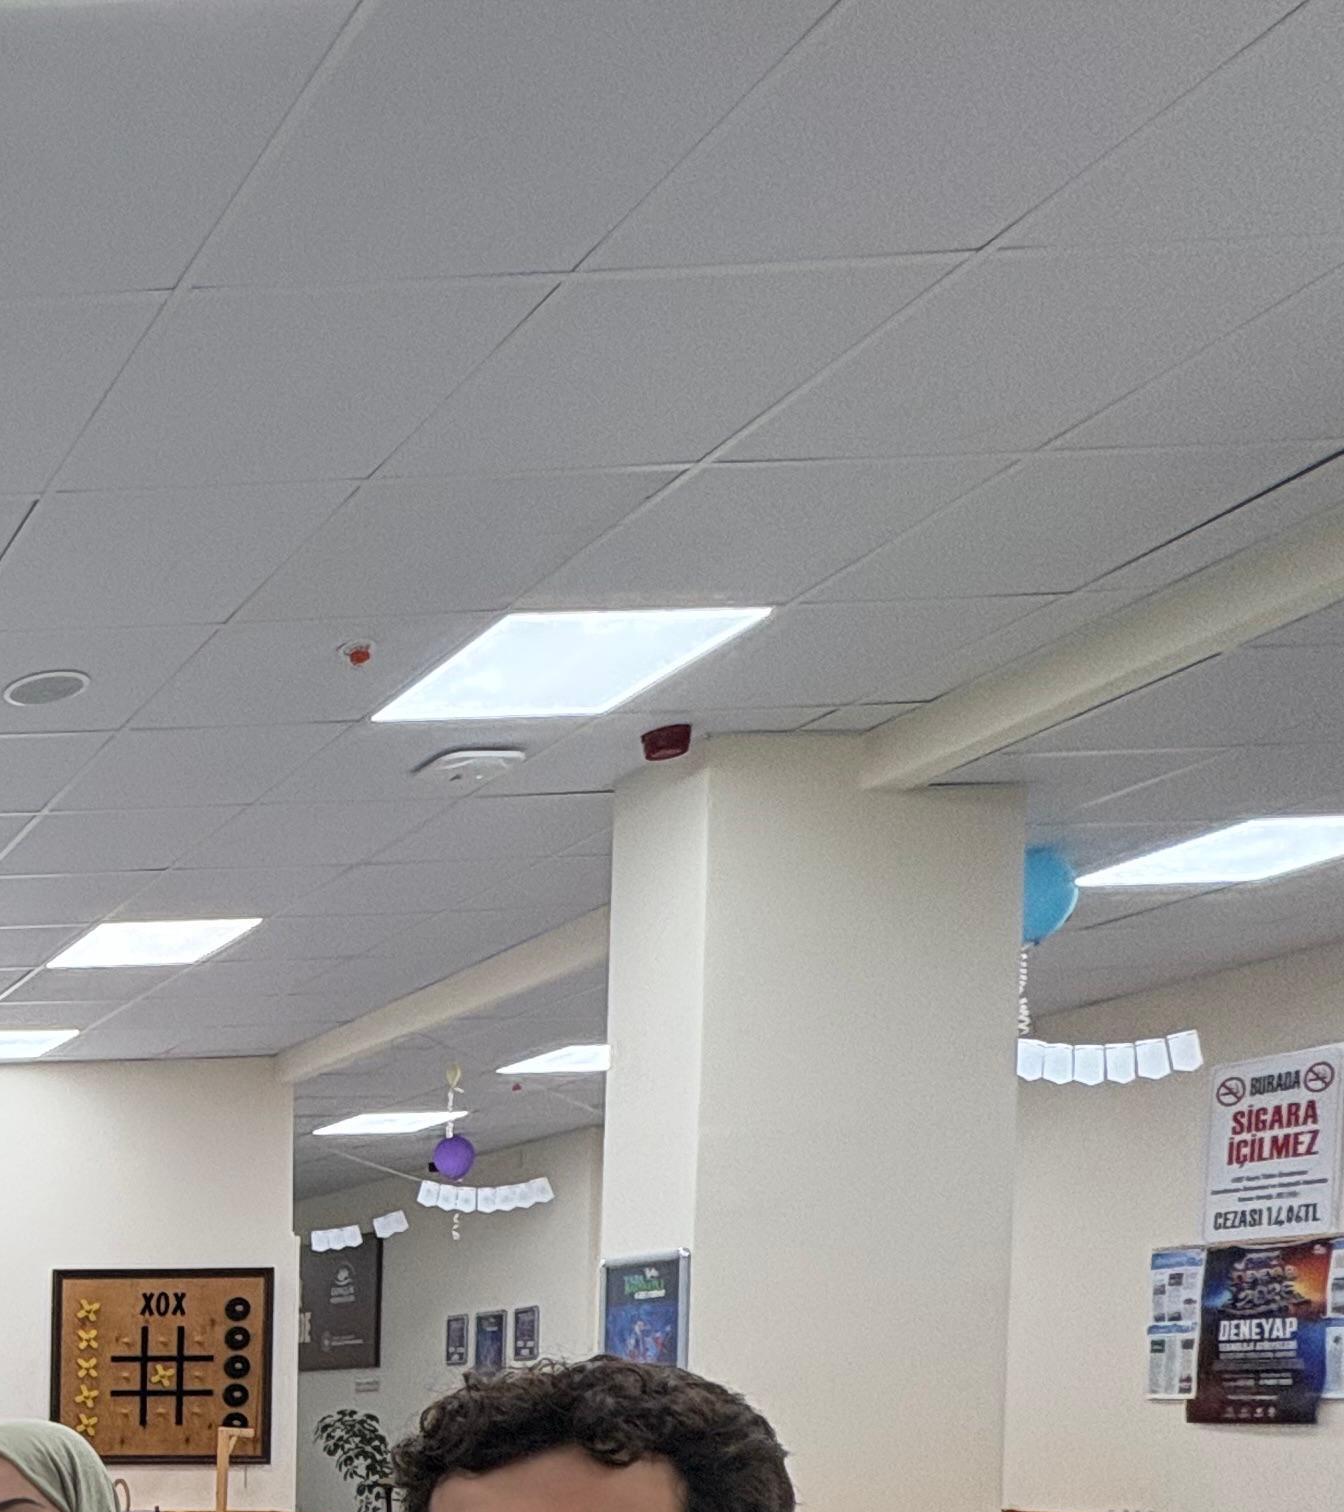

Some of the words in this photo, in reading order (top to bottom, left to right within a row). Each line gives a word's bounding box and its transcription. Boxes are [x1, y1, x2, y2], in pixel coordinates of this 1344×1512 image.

[1249, 1070, 1300, 1096] BURADA
[1231, 1099, 1318, 1135] SİGARA
[1226, 1129, 1320, 1168] İÇİLMEZ
[1213, 1207, 1263, 1231] CEZASI
[140, 1291, 186, 1316] XOX
[1218, 1317, 1298, 1341] DENEYAP
